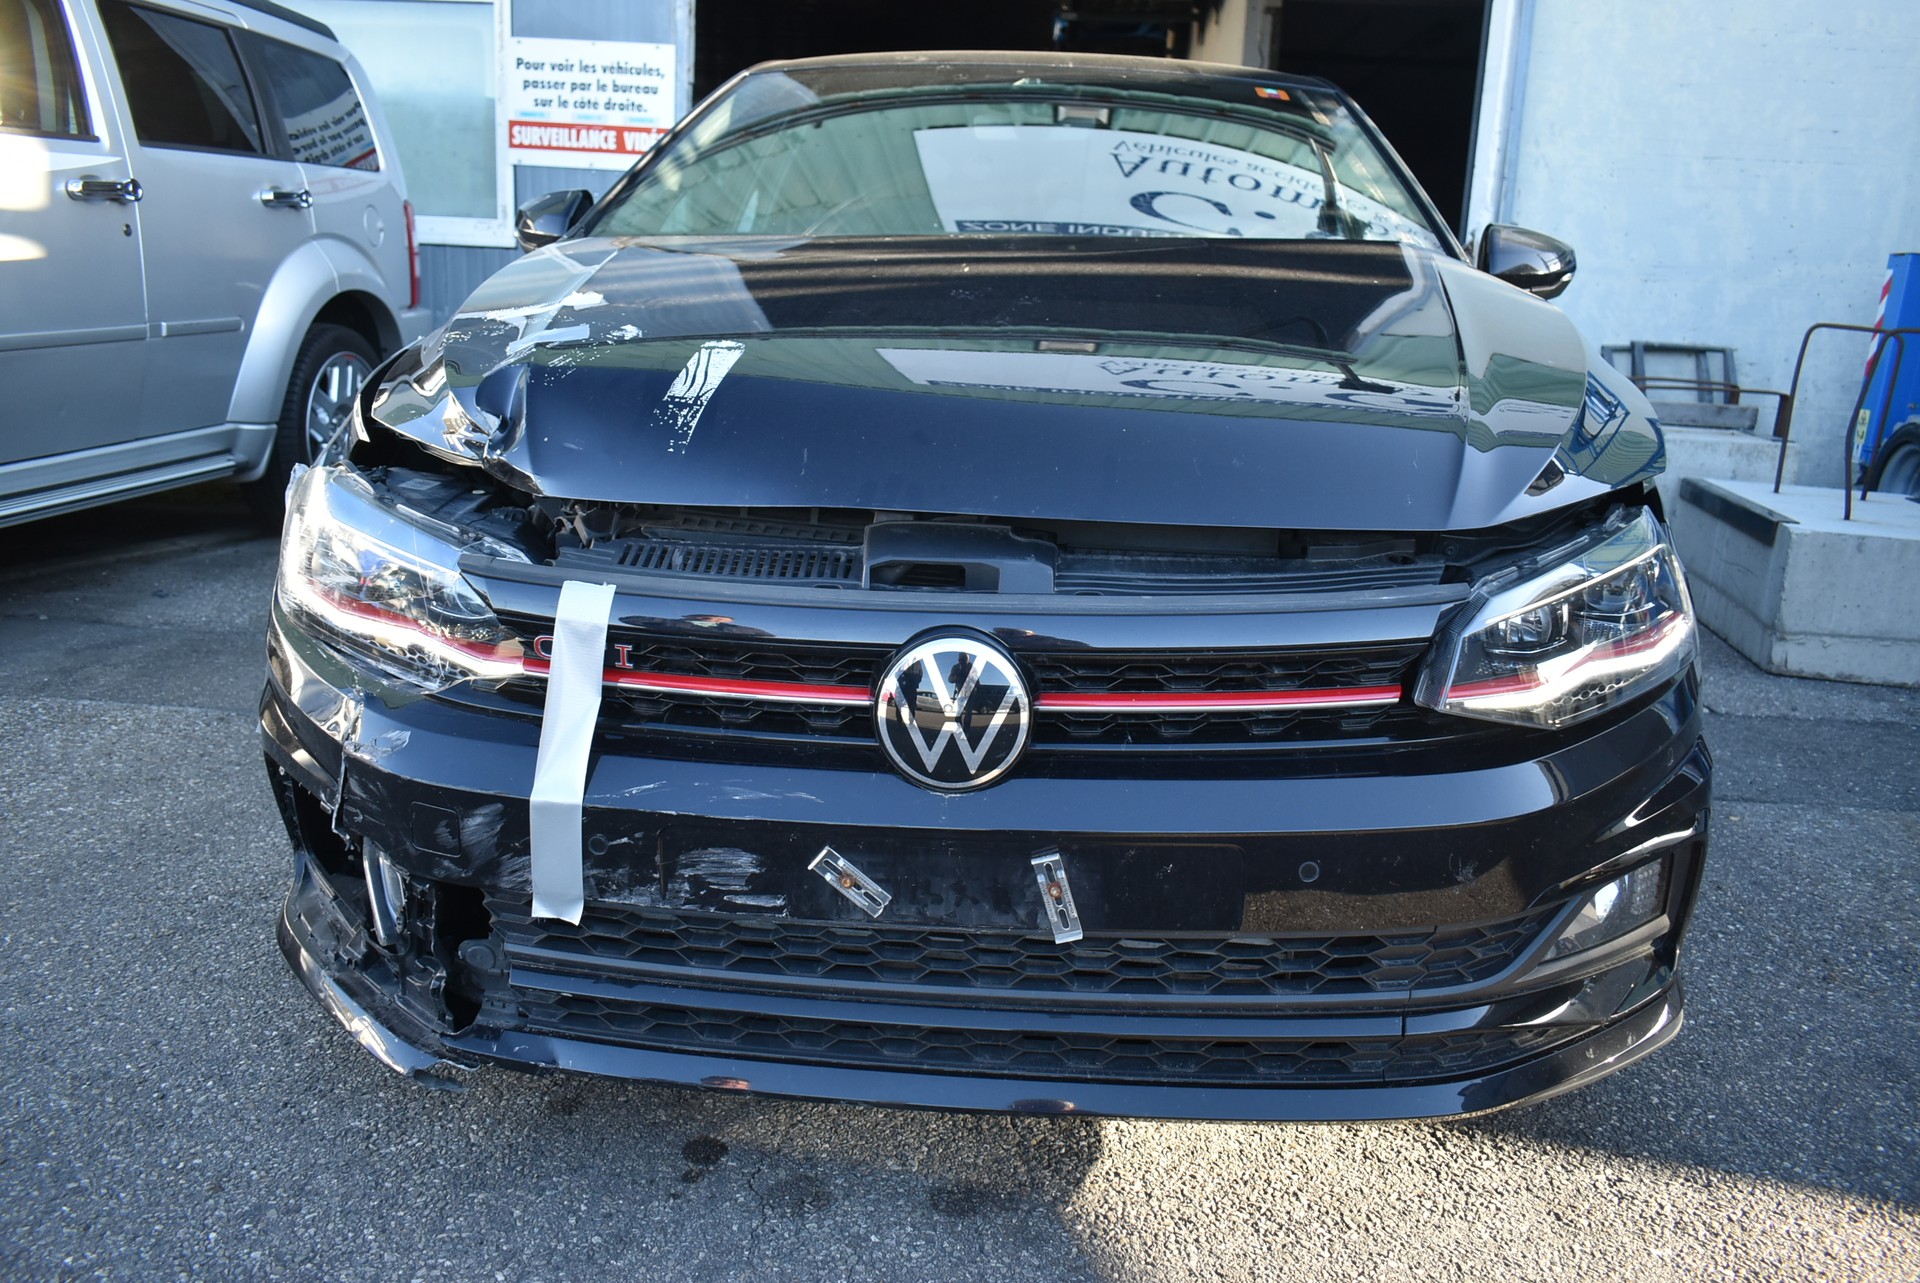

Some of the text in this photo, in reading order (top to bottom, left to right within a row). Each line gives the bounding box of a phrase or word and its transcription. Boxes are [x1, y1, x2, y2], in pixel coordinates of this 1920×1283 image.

[516, 57, 545, 71] Pour
[550, 59, 574, 72] voir
[579, 59, 597, 73] les
[523, 79, 658, 94] passer par le bureau
[534, 98, 553, 107] sur
[558, 95, 569, 108] le
[604, 97, 647, 112] droite.
[511, 124, 667, 151] SURVEILLANCE VIDÉ
[533, 635, 634, 669] GI
